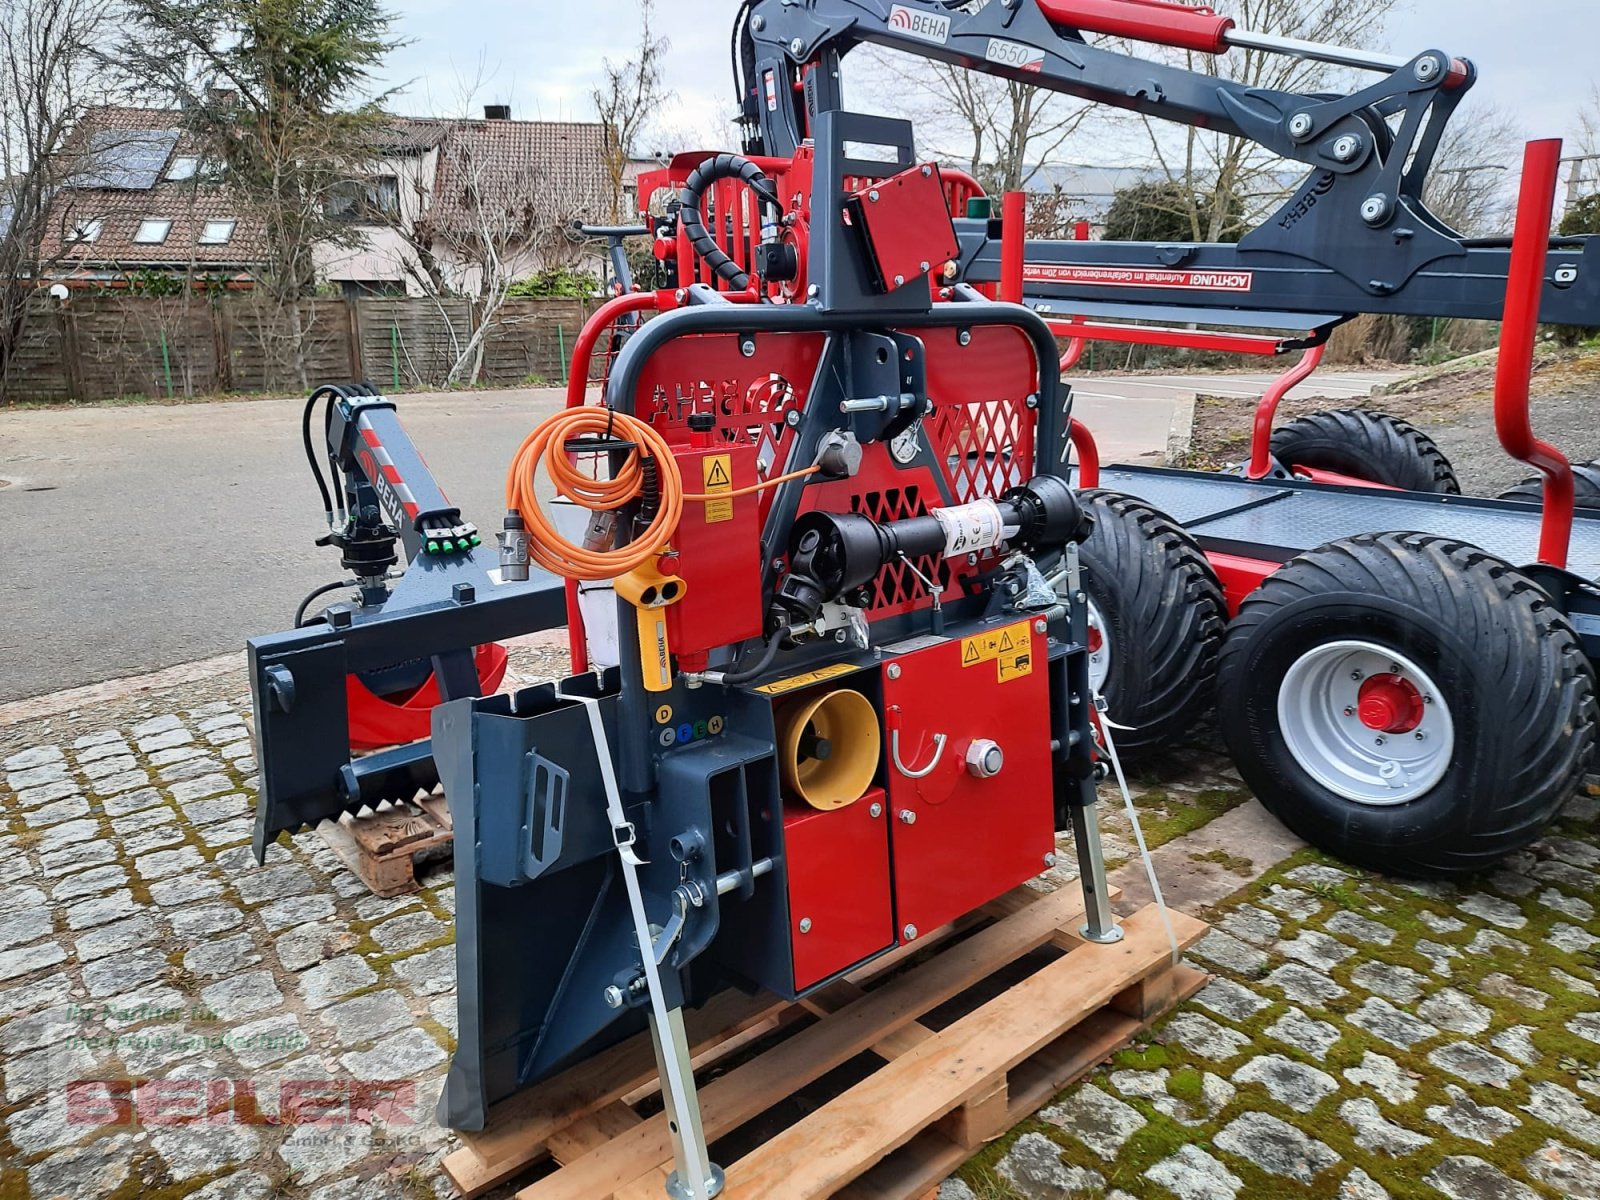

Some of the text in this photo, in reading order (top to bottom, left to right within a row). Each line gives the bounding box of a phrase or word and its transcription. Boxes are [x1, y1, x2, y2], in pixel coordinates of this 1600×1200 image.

[911, 14, 946, 38] BEHA
[988, 40, 1029, 65] 6550
[1278, 188, 1318, 230] BEHA
[1042, 267, 1057, 277] 20m
[1058, 268, 1071, 277] von
[1072, 268, 1132, 280] Gefahrenbereich
[1134, 272, 1144, 281] im
[1145, 272, 1186, 282] Aufenthalt
[1189, 274, 1248, 288] ACHTUNG!
[376, 472, 404, 529] BEHA
